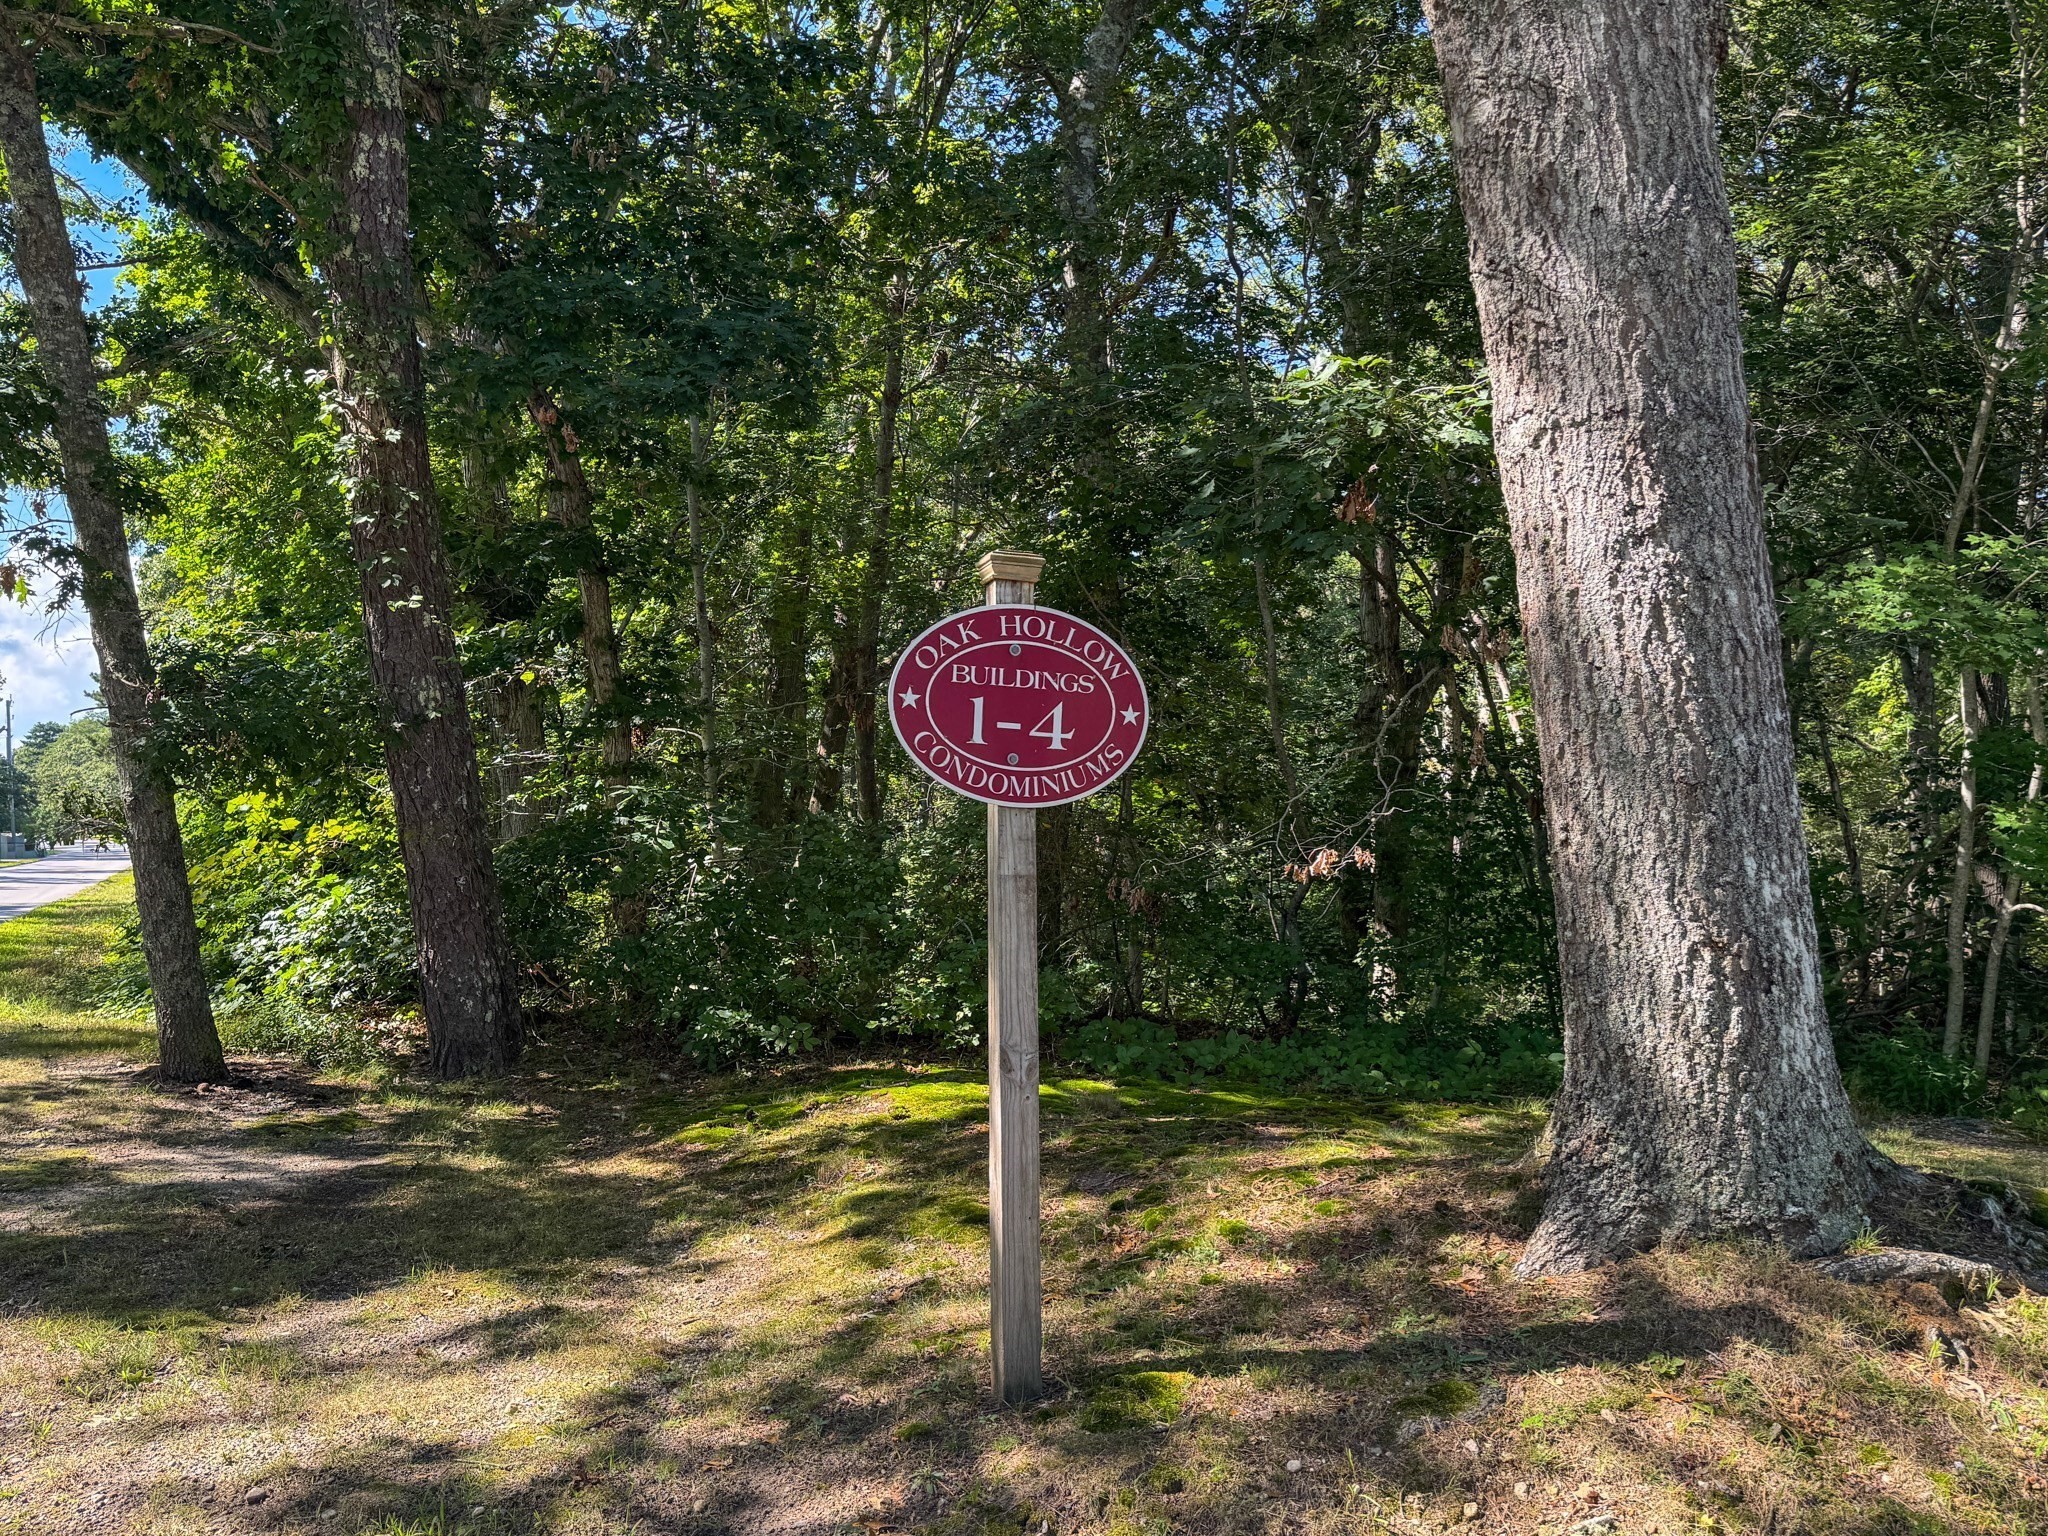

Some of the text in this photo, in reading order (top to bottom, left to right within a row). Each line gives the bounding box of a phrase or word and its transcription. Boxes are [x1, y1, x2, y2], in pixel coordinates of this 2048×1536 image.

[915, 615, 1130, 680] OAK HOLLOW
[951, 664, 1096, 693] BUILDINGS
[913, 731, 1124, 798] CONDOMINIUMS
